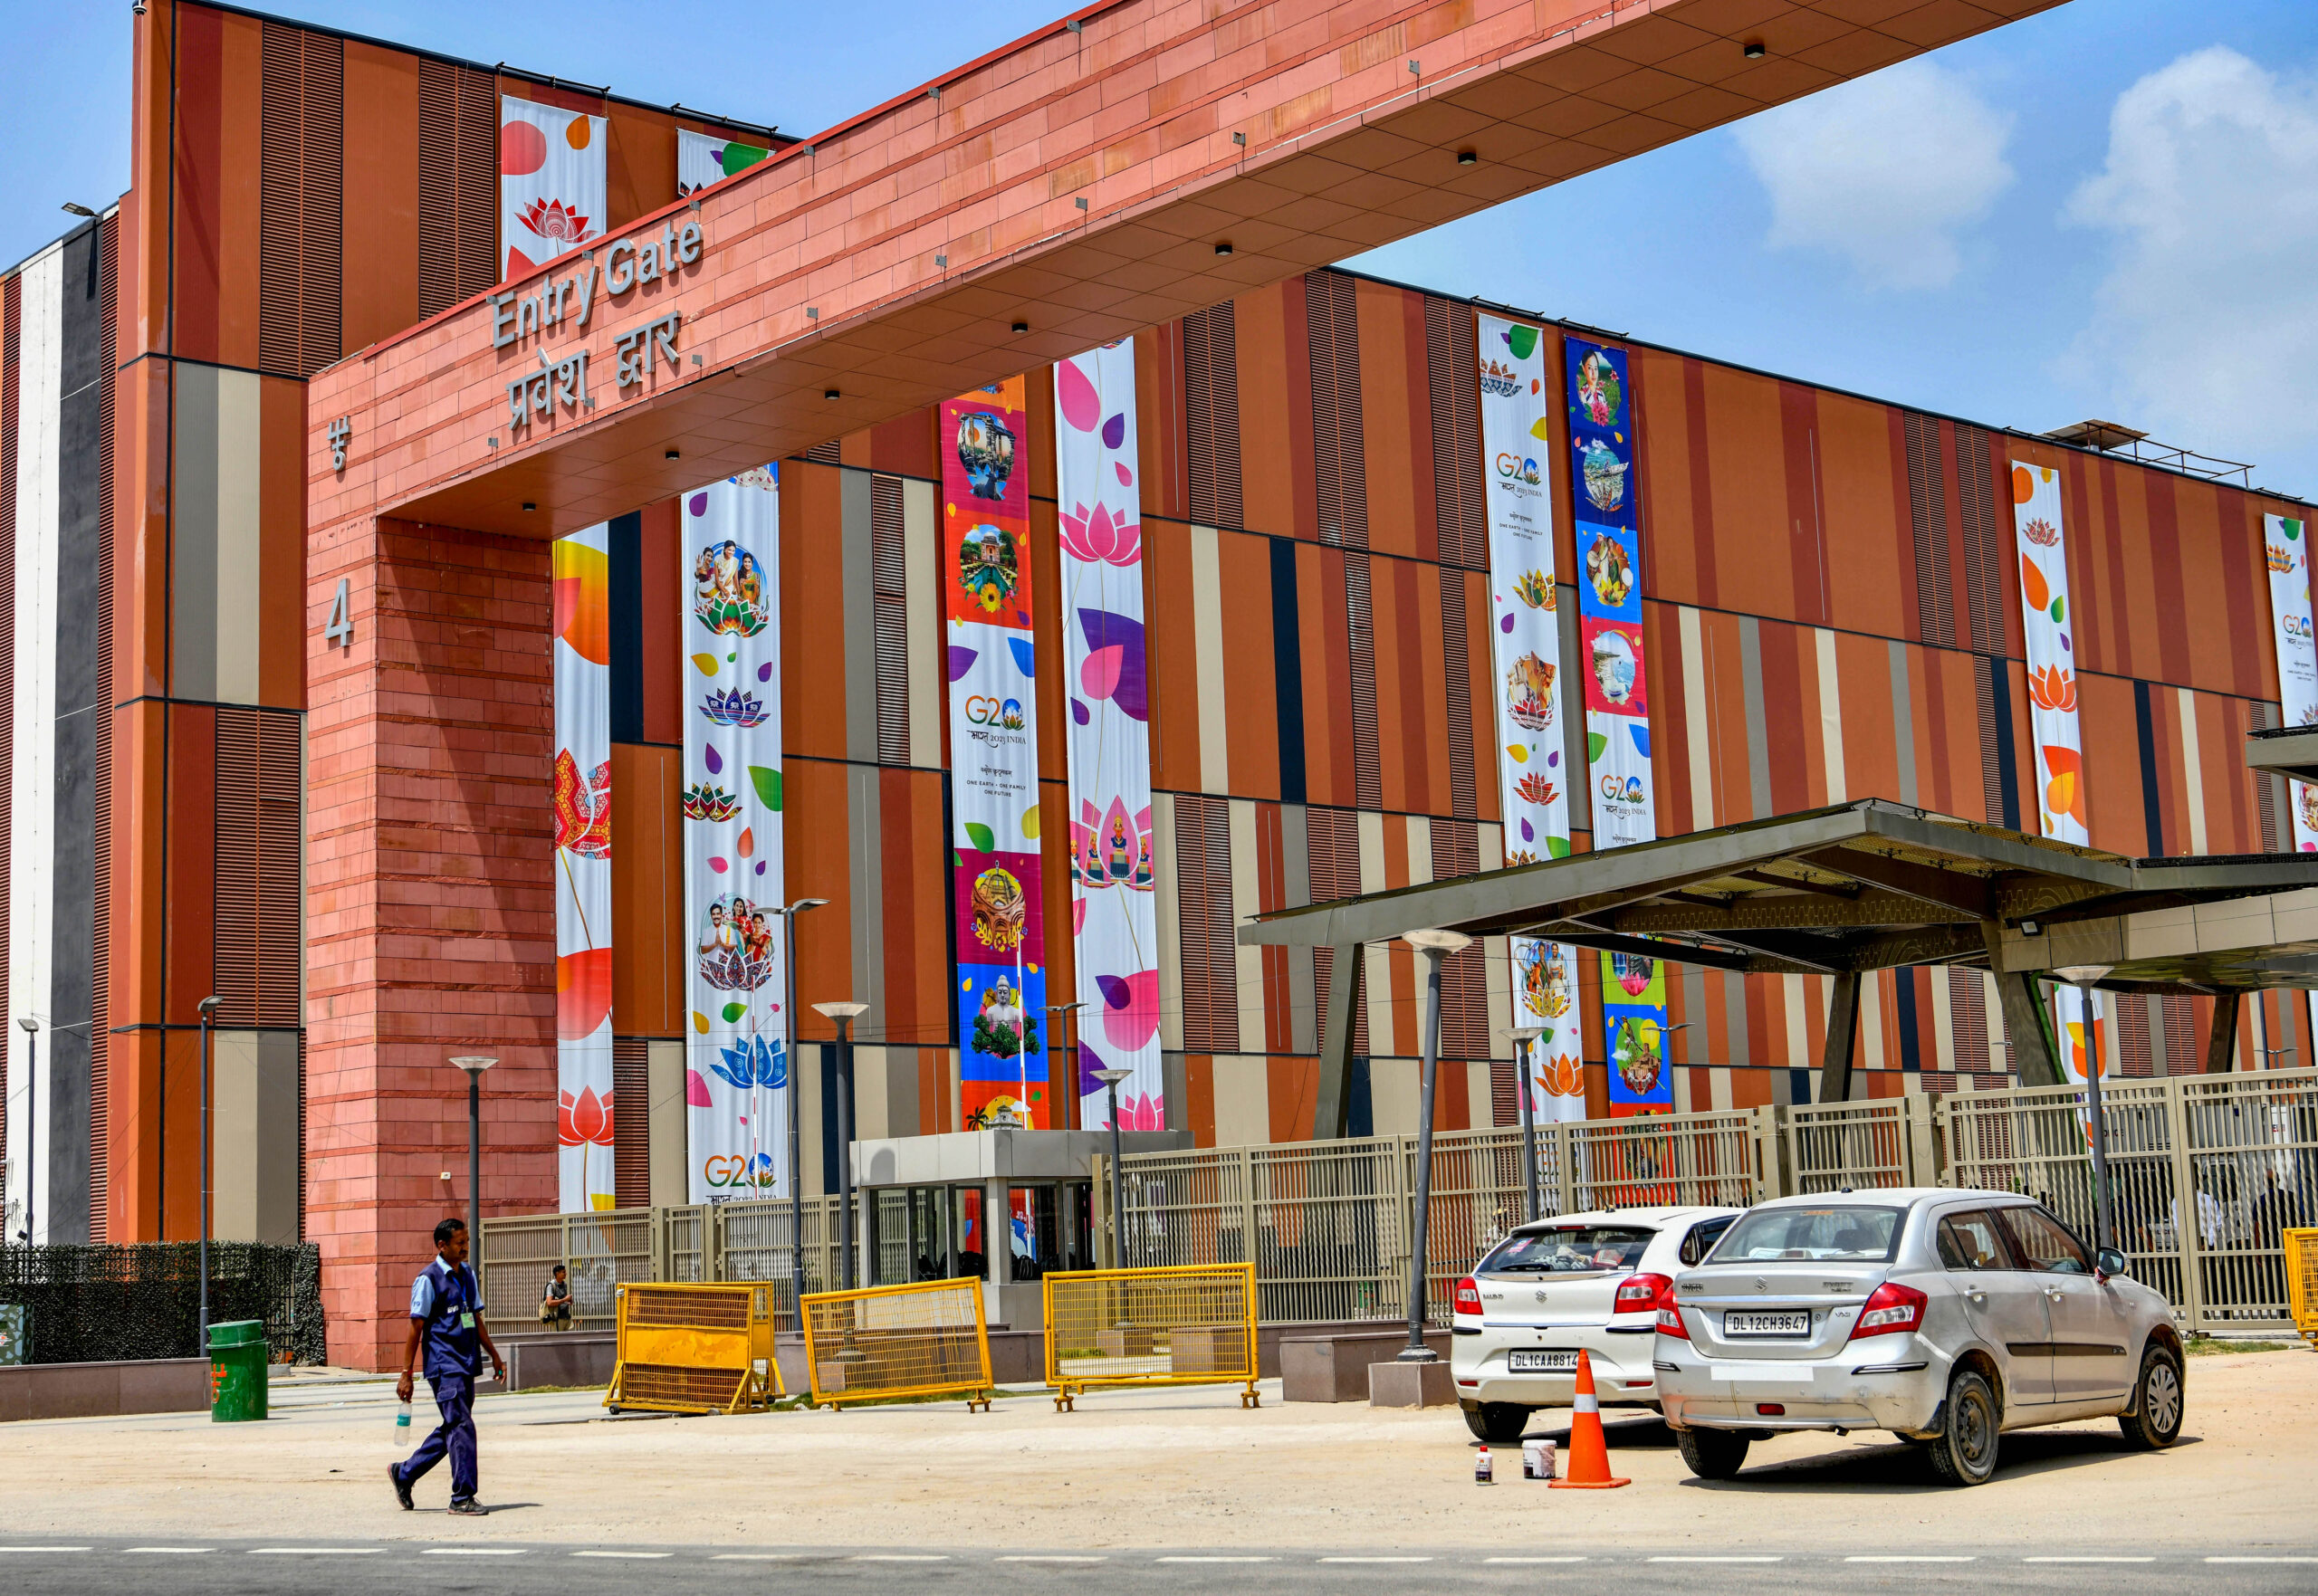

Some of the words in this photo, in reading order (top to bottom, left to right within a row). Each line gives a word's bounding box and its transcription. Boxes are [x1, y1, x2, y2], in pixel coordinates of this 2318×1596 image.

[493, 265, 599, 349] Entry
[605, 220, 704, 295] Gate
[505, 347, 589, 430] प्रवेश
[613, 311, 683, 387] द्वार
[1497, 453, 1542, 485] G20
[325, 578, 351, 646] 4
[965, 695, 1025, 731] G20
[991, 734, 1006, 744] 2023
[1007, 735, 1027, 745] INDIA
[1601, 775, 1644, 804] G20
[1631, 808, 1646, 816] INDIA
[704, 1152, 777, 1188] G20
[1733, 1316, 1806, 1331] DL12CH3647
